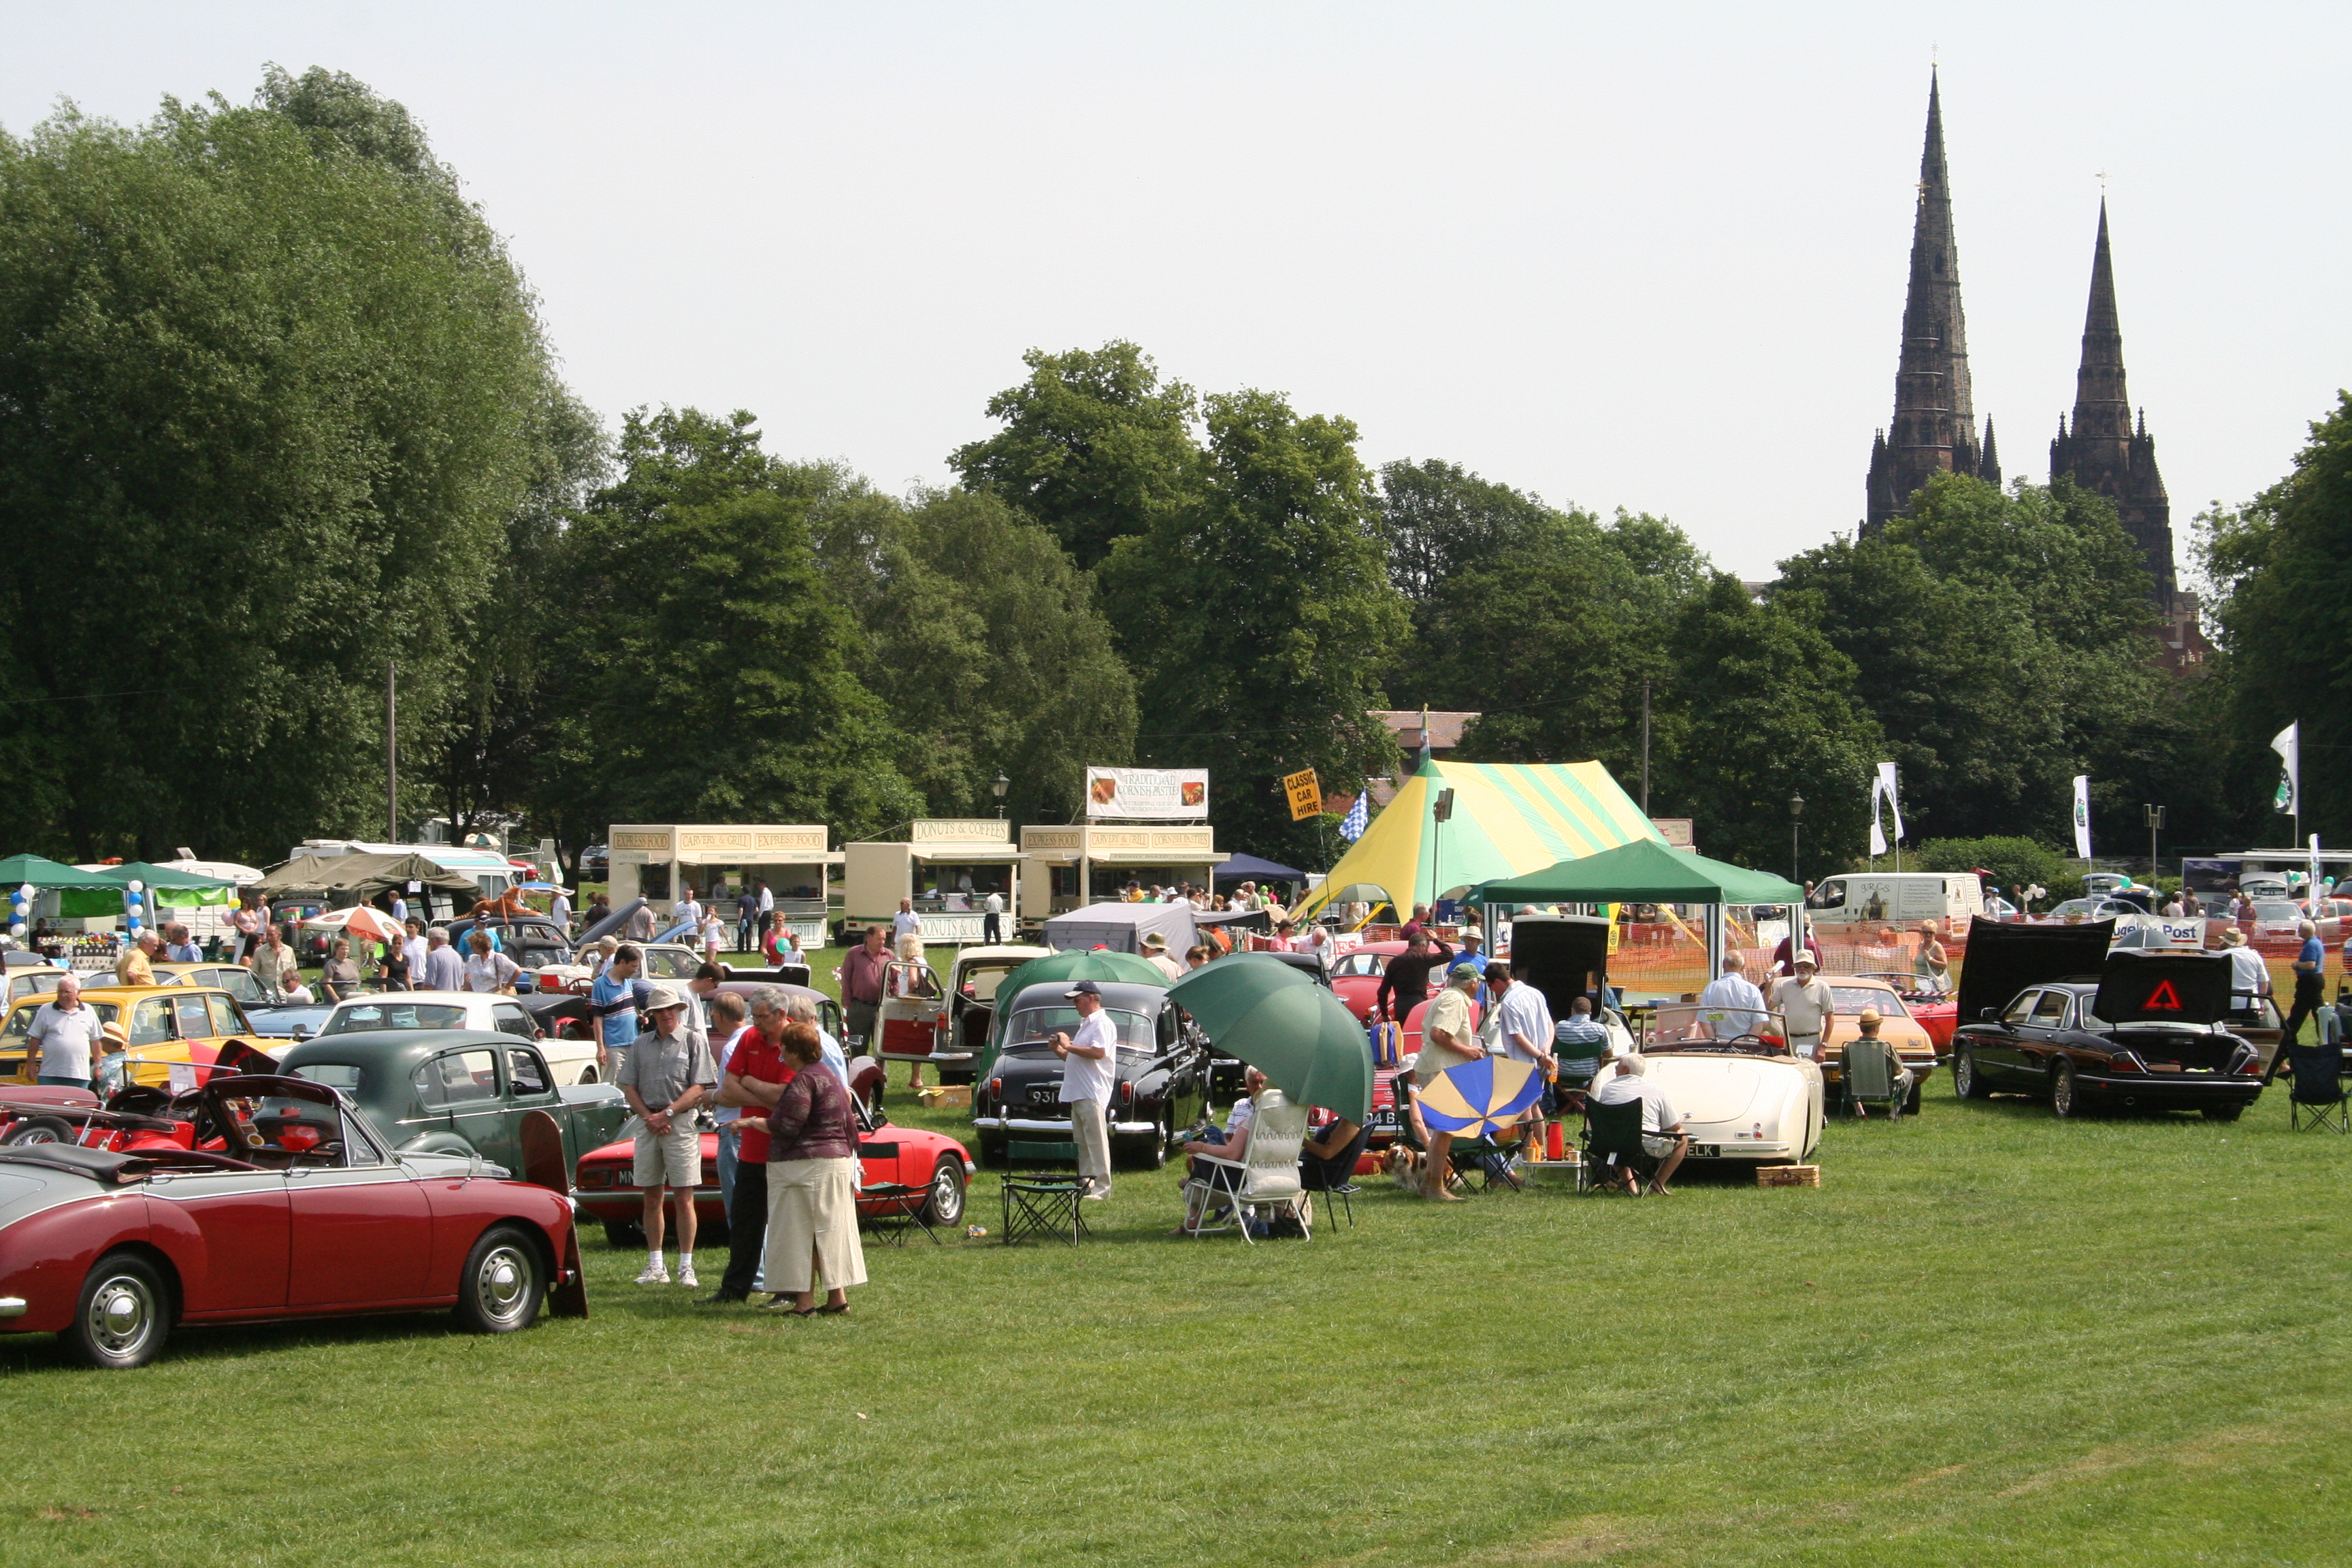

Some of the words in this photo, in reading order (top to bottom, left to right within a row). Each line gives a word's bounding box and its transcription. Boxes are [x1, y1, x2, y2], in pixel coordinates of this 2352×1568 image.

[1124, 774, 1175, 785] TRADITIONAL
[1287, 771, 1315, 790] CLASSIC
[1117, 785, 1152, 796] CORNISH
[1153, 786, 1179, 796] PASTIES
[1296, 789, 1313, 802] CAR
[1296, 801, 1318, 816] HIRE
[917, 822, 954, 839] DONUTS
[958, 823, 966, 834] &
[969, 822, 1005, 838] COFFEES
[617, 835, 646, 847] EXPRESS
[647, 835, 667, 848] FOOD
[683, 835, 716, 847] CARVERY
[719, 835, 725, 845] &
[728, 835, 748, 847] GRILL
[757, 835, 794, 847] EXPRESS
[797, 835, 820, 846] FOOD
[1028, 834, 1056, 846] EXPRESS
[1058, 834, 1077, 846] FOOD
[1092, 834, 1120, 845] CARVERY
[1121, 835, 1127, 843] &
[1129, 835, 1146, 845] GRILL
[1154, 835, 1182, 845] CORNISH
[1183, 835, 1207, 845] PASTIES
[919, 919, 957, 936] DONUTS
[960, 919, 968, 935] &
[2163, 925, 2196, 939] Post
[1687, 1145, 1712, 1156] ELK
